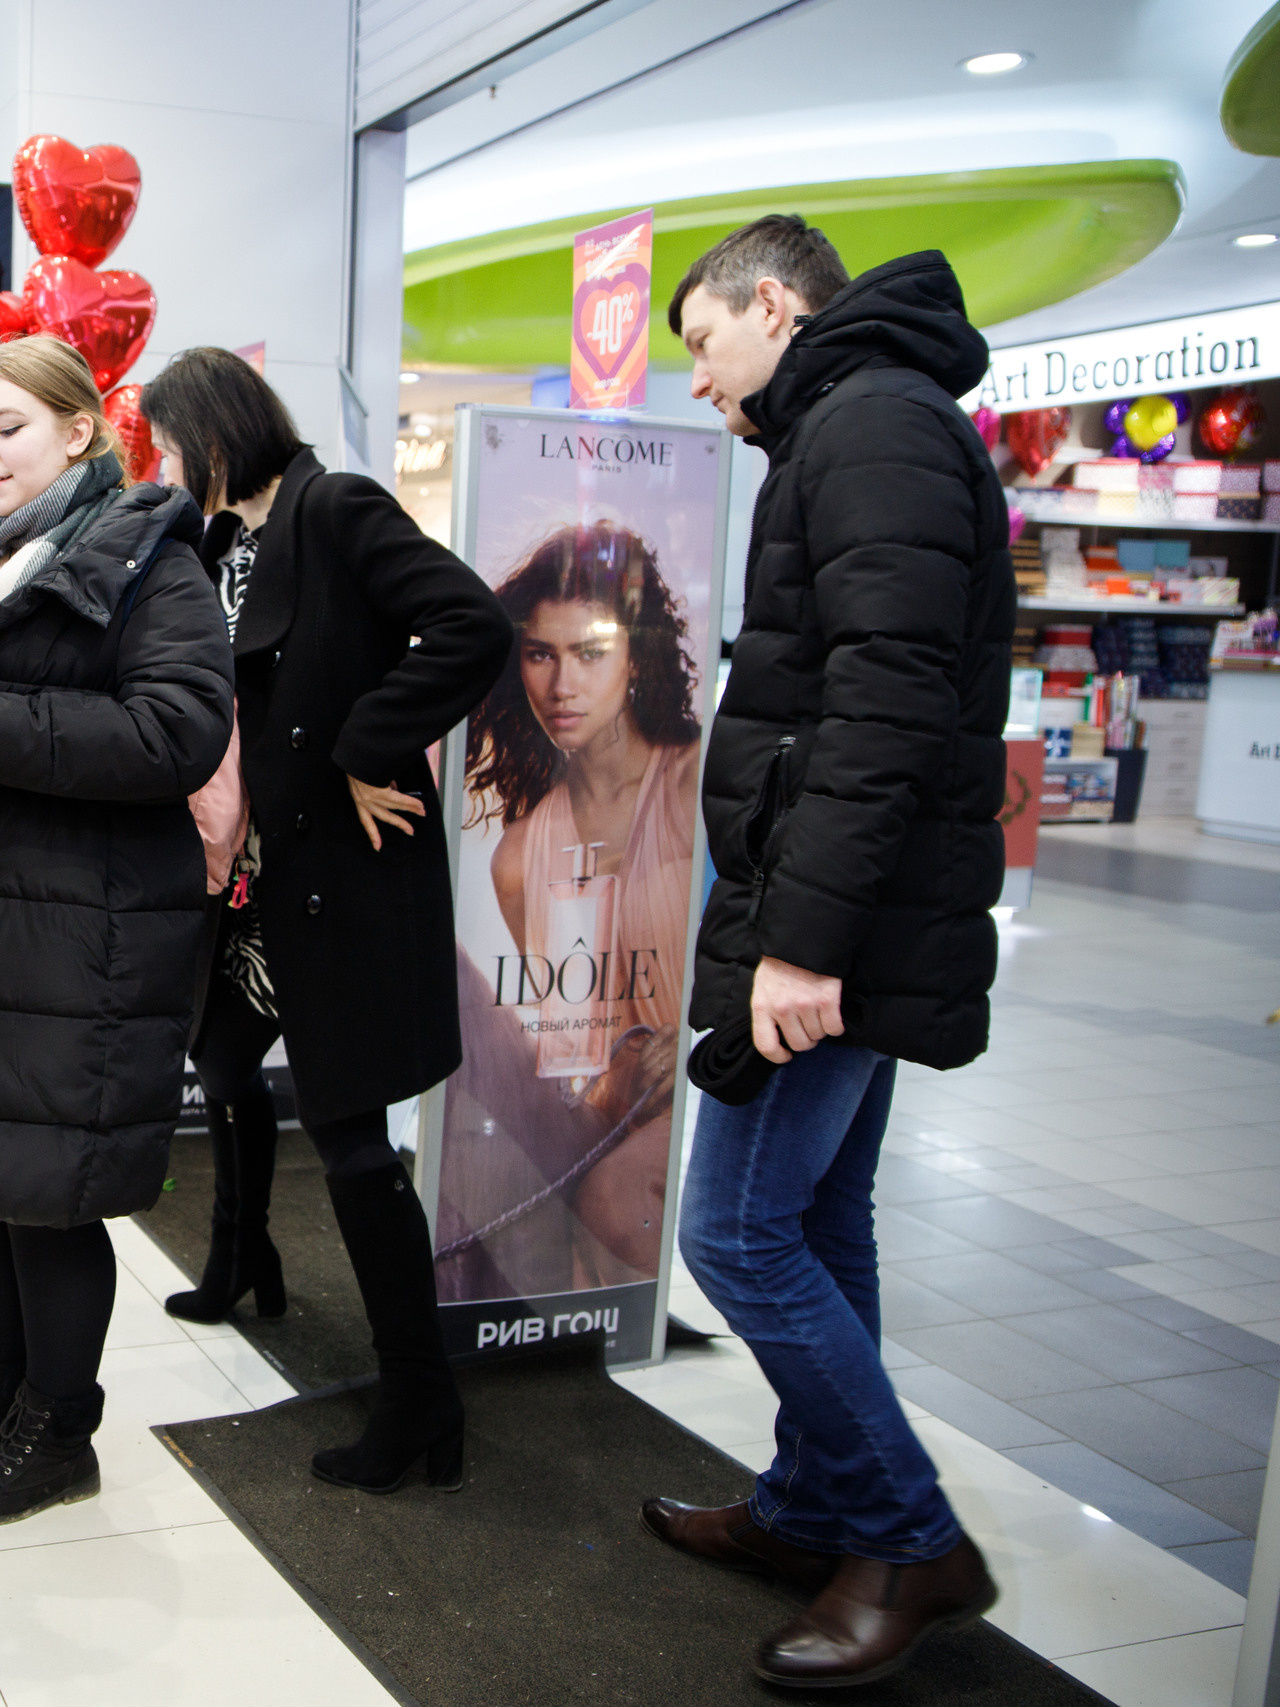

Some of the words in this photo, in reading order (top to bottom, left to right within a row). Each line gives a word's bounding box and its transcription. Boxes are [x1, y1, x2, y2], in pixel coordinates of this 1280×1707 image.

[979, 362, 1029, 406] Art
[1044, 332, 1260, 396] Decoration
[540, 433, 674, 467] LANCÔME
[591, 463, 623, 473] PARIS
[490, 936, 658, 1007] IDÔLE
[521, 1017, 570, 1033] НОВЫЙ
[572, 1015, 622, 1031] АРОМАТ
[477, 1317, 546, 1349] РИВ
